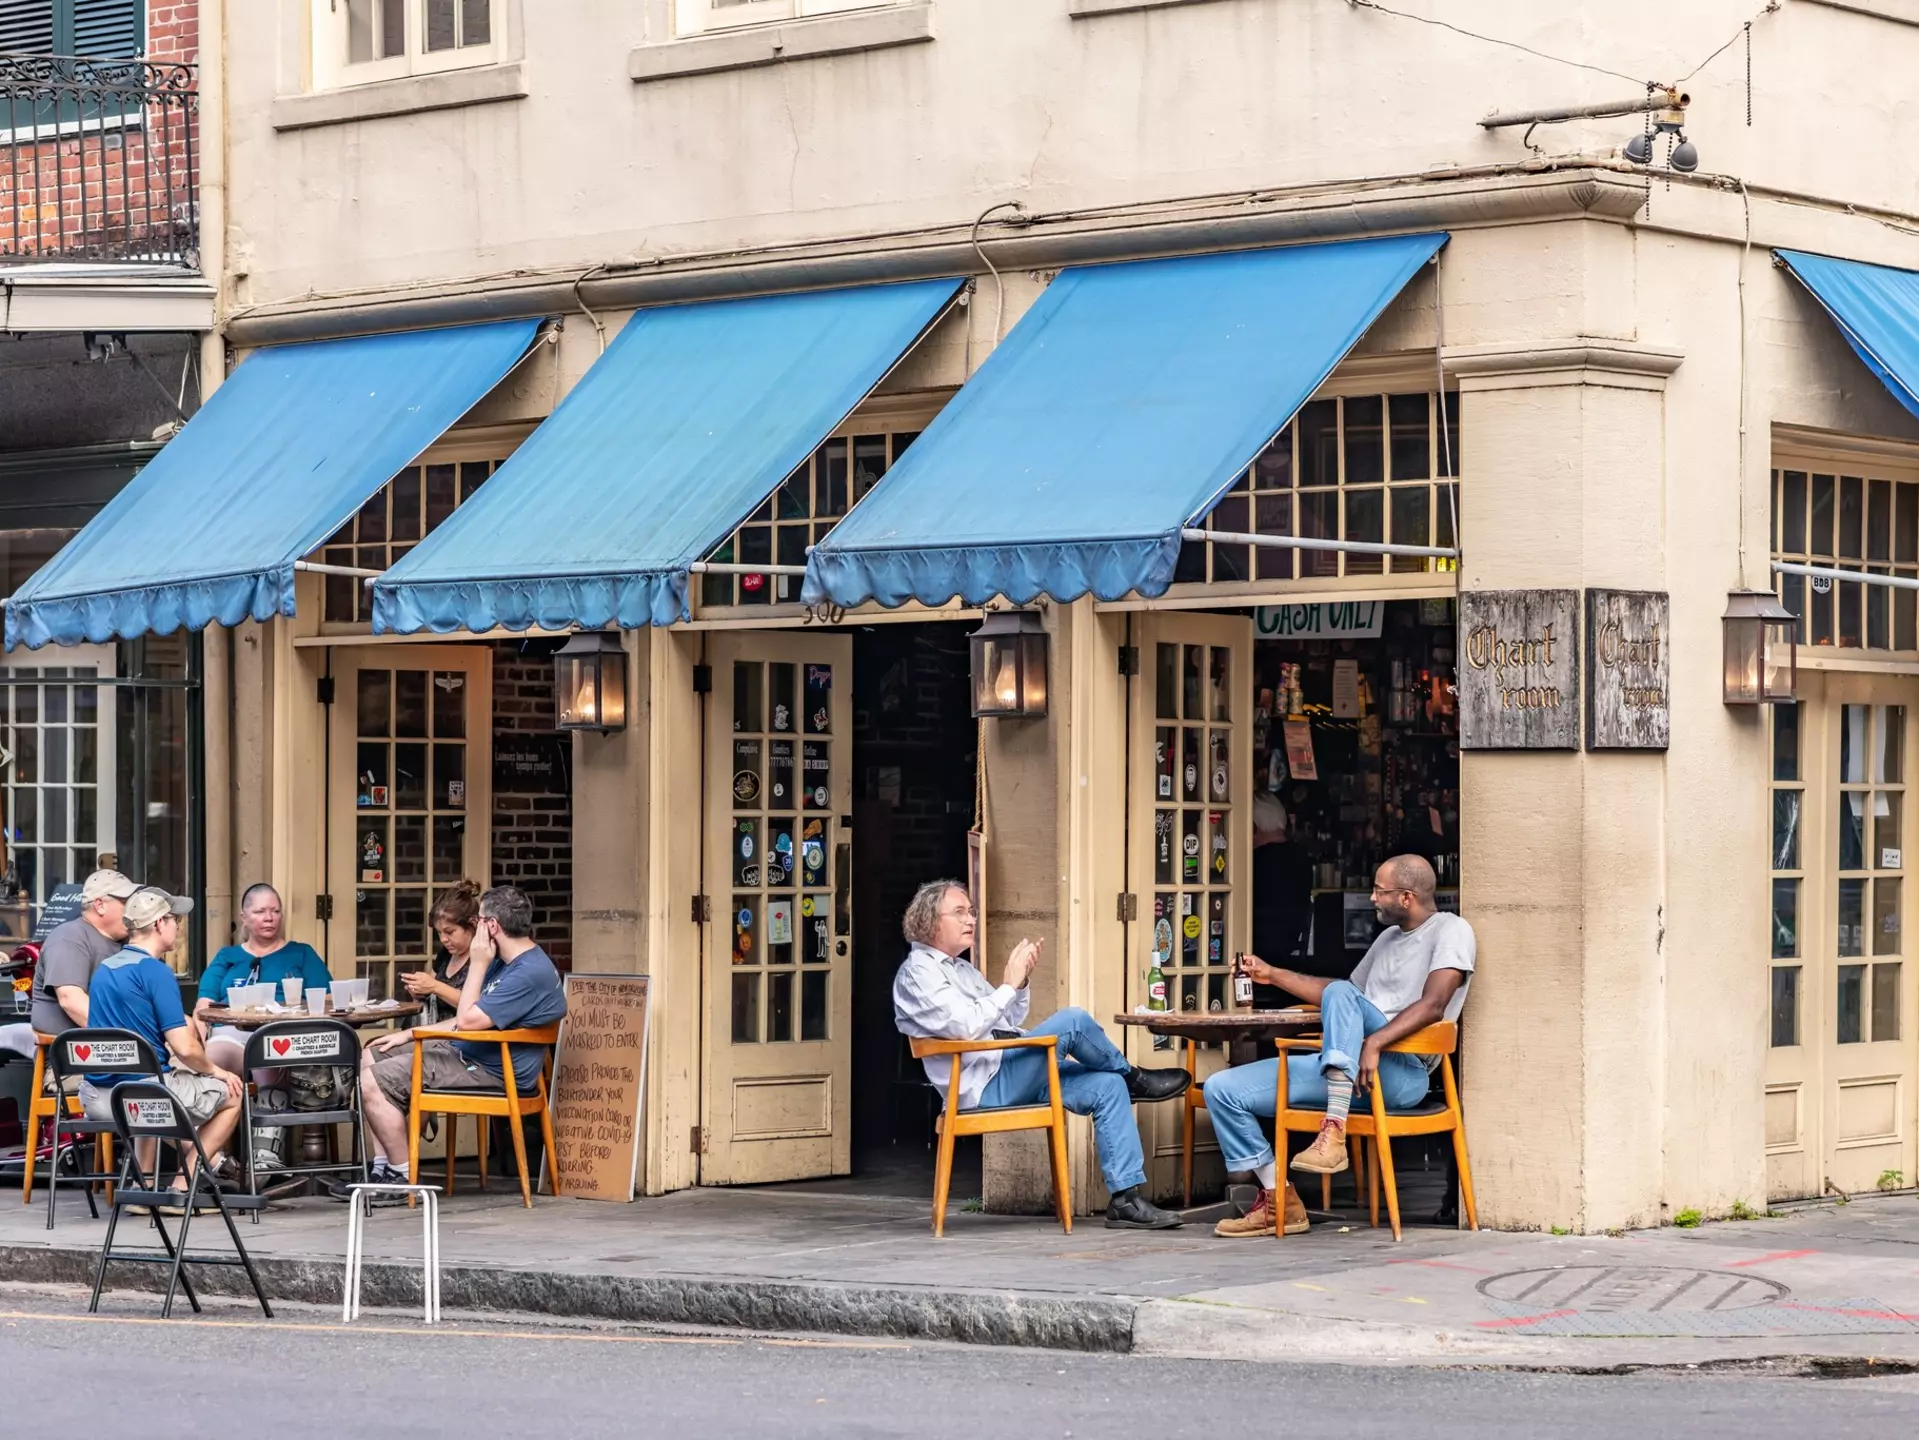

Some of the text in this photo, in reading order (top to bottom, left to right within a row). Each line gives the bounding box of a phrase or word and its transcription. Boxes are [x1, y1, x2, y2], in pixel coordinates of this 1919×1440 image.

[1257, 603, 1321, 635] CASH
[1466, 622, 1557, 687] Chart
[1598, 619, 1662, 687] Chart
[1500, 685, 1561, 711] room
[1623, 685, 1663, 711] room
[1186, 839, 1197, 849] DIP
[572, 981, 584, 992] PER
[91, 1044, 101, 1052] THE
[102, 1043, 118, 1052] CHART
[119, 1043, 136, 1052] ROOM
[266, 1034, 338, 1057] I THE CHART ROOM
[604, 1033, 615, 1049] TO
[616, 1032, 639, 1049] ENTER
